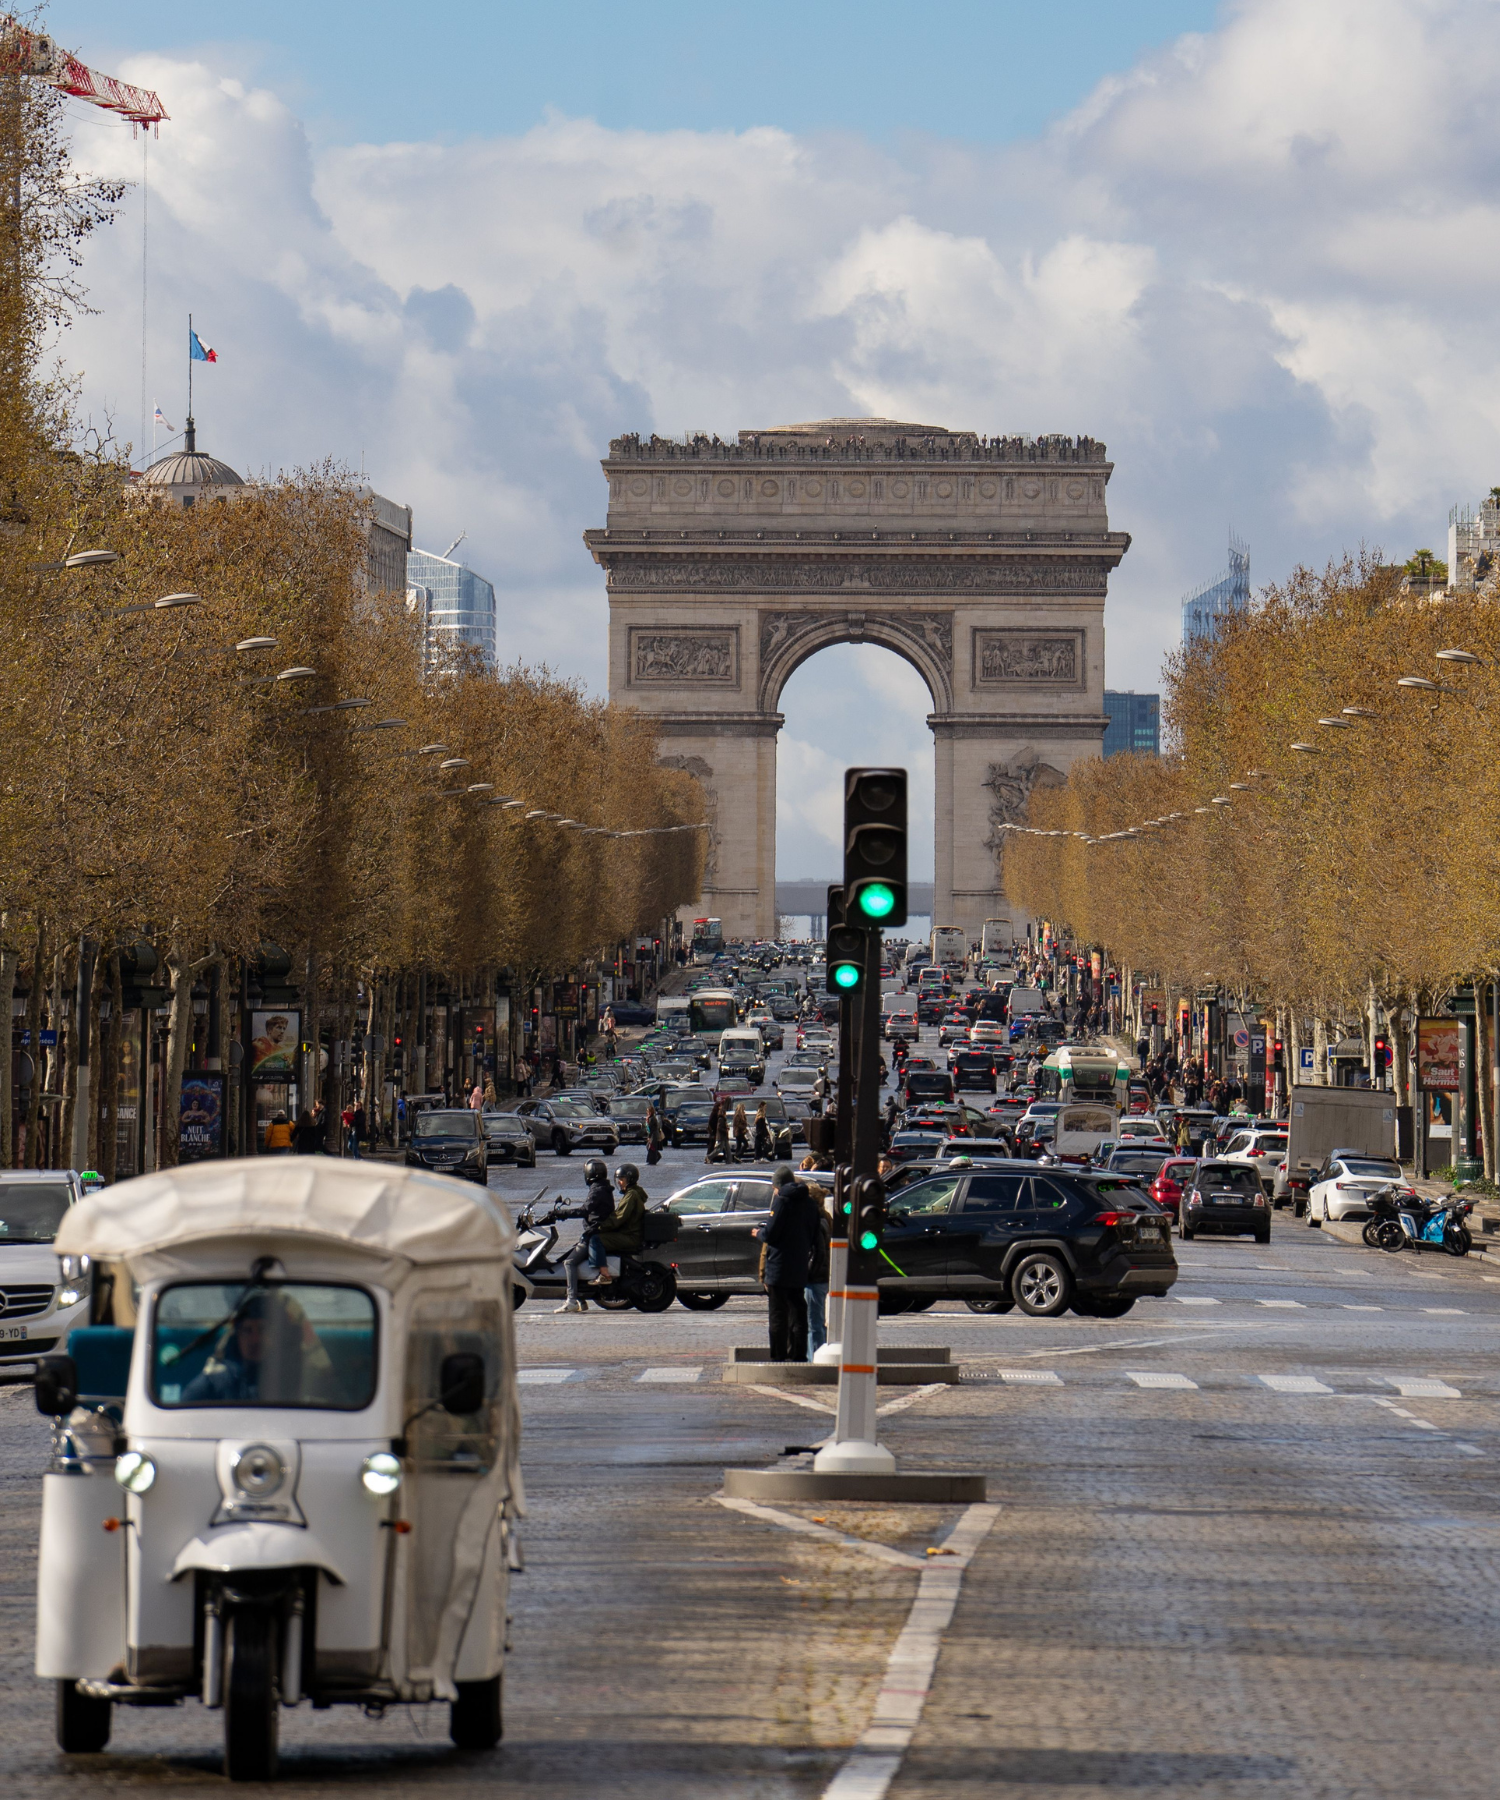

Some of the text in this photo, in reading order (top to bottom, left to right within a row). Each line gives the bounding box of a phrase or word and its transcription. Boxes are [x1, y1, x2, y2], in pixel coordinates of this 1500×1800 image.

[1253, 1040, 1263, 1054] P
[1305, 1051, 1314, 1065] P
[1431, 1067, 1454, 1076] Saut
[1423, 1077, 1460, 1086] Hermès
[188, 1126, 203, 1134] NUIT
[180, 1133, 211, 1143] BLANCHE
